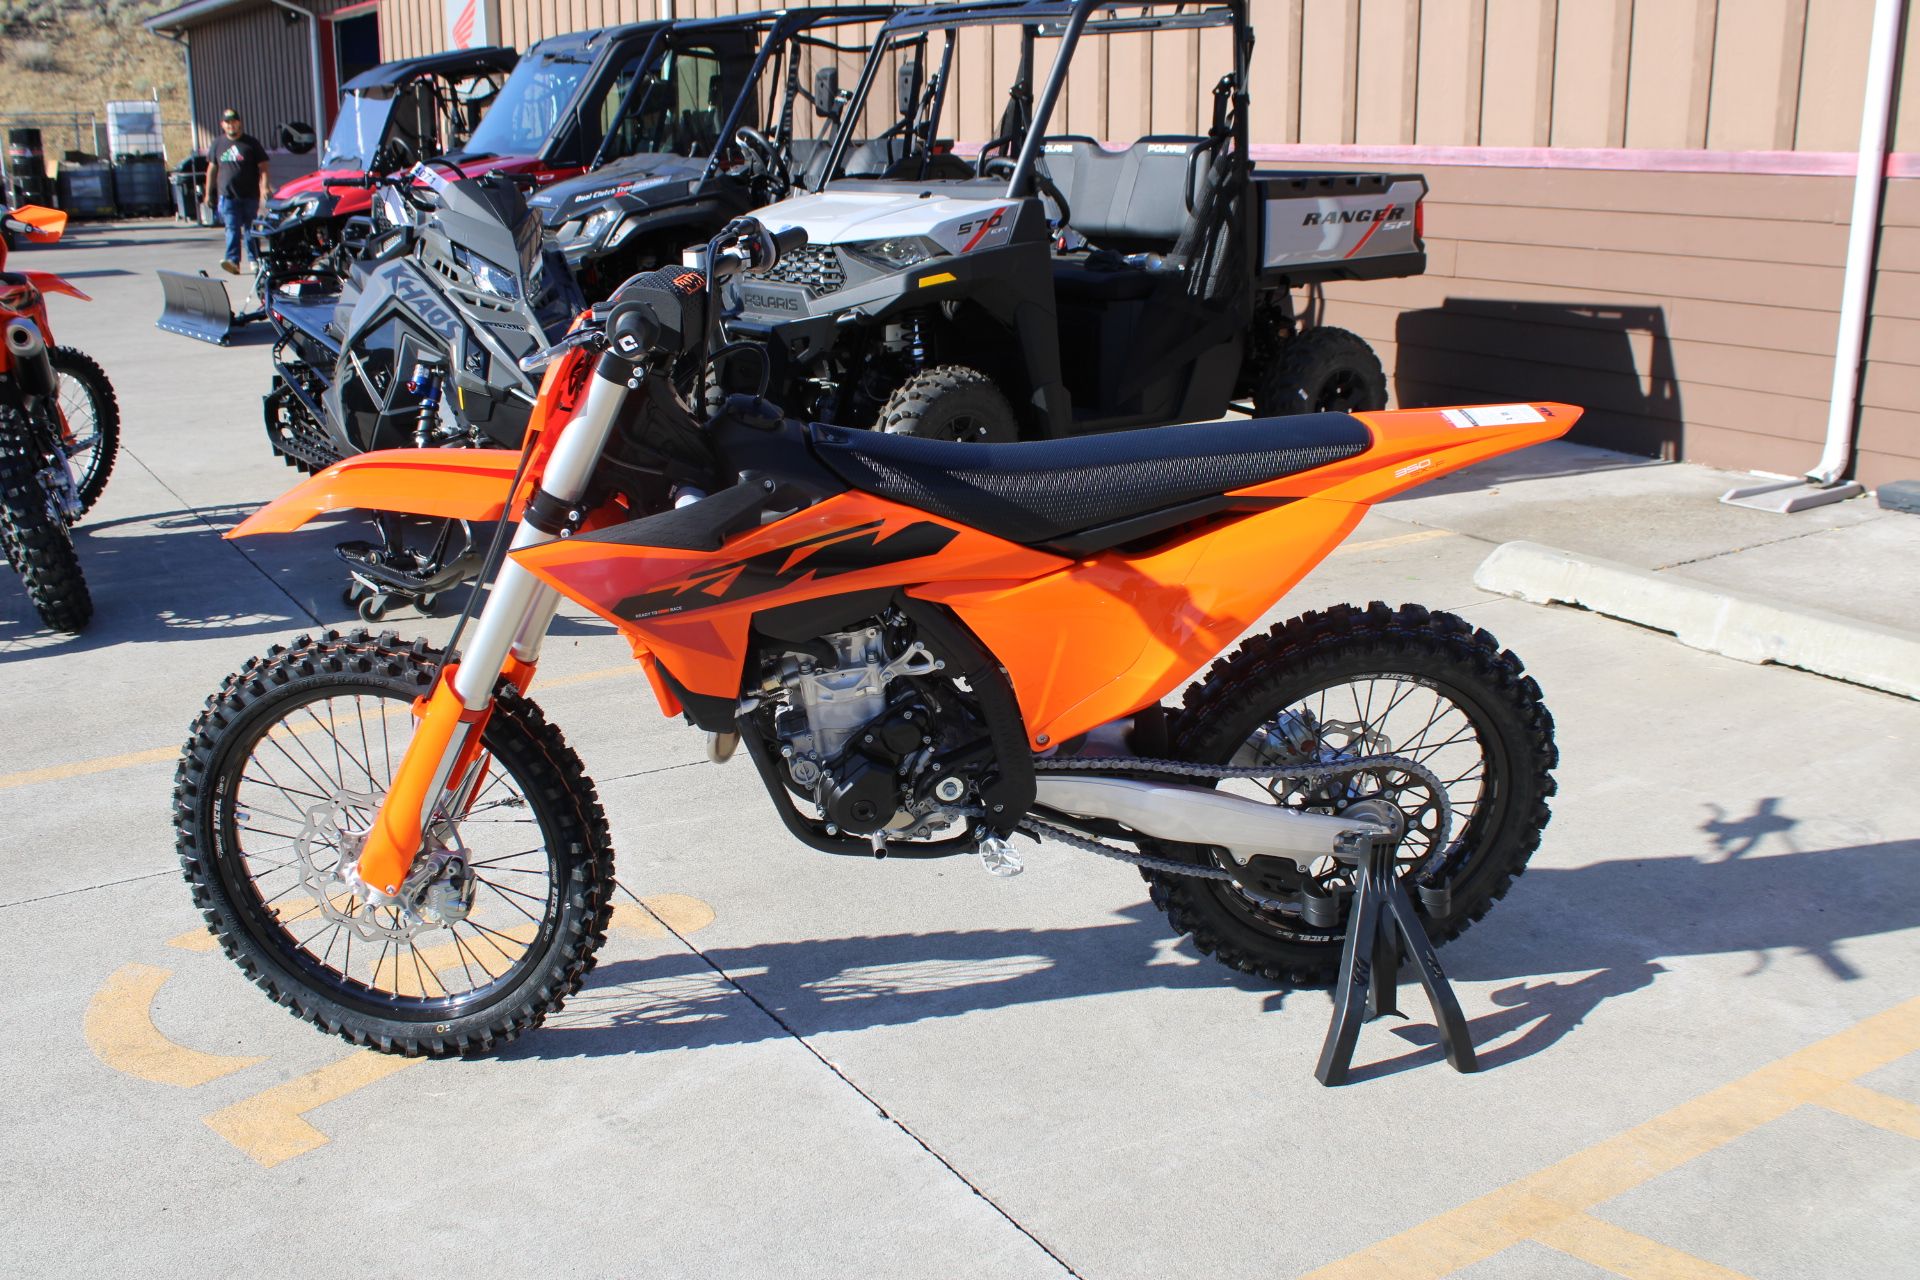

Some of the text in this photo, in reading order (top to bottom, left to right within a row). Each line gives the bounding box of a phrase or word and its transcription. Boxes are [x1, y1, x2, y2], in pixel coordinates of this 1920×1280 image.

[1147, 145, 1187, 153] POLARIS
[575, 193, 592, 203] Dual
[593, 187, 616, 199] Clutch
[957, 215, 1003, 235] 570
[1302, 207, 1405, 226] RANGER
[1383, 221, 1411, 231] SP
[382, 263, 463, 340] KHAOS
[744, 293, 798, 311] POLARIS
[1394, 458, 1431, 478] 350
[1381, 673, 1414, 682] EXCEL
[213, 798, 222, 831] EXCEL
[549, 886, 559, 919] EXCEL
[1298, 934, 1330, 942] EXCEL
